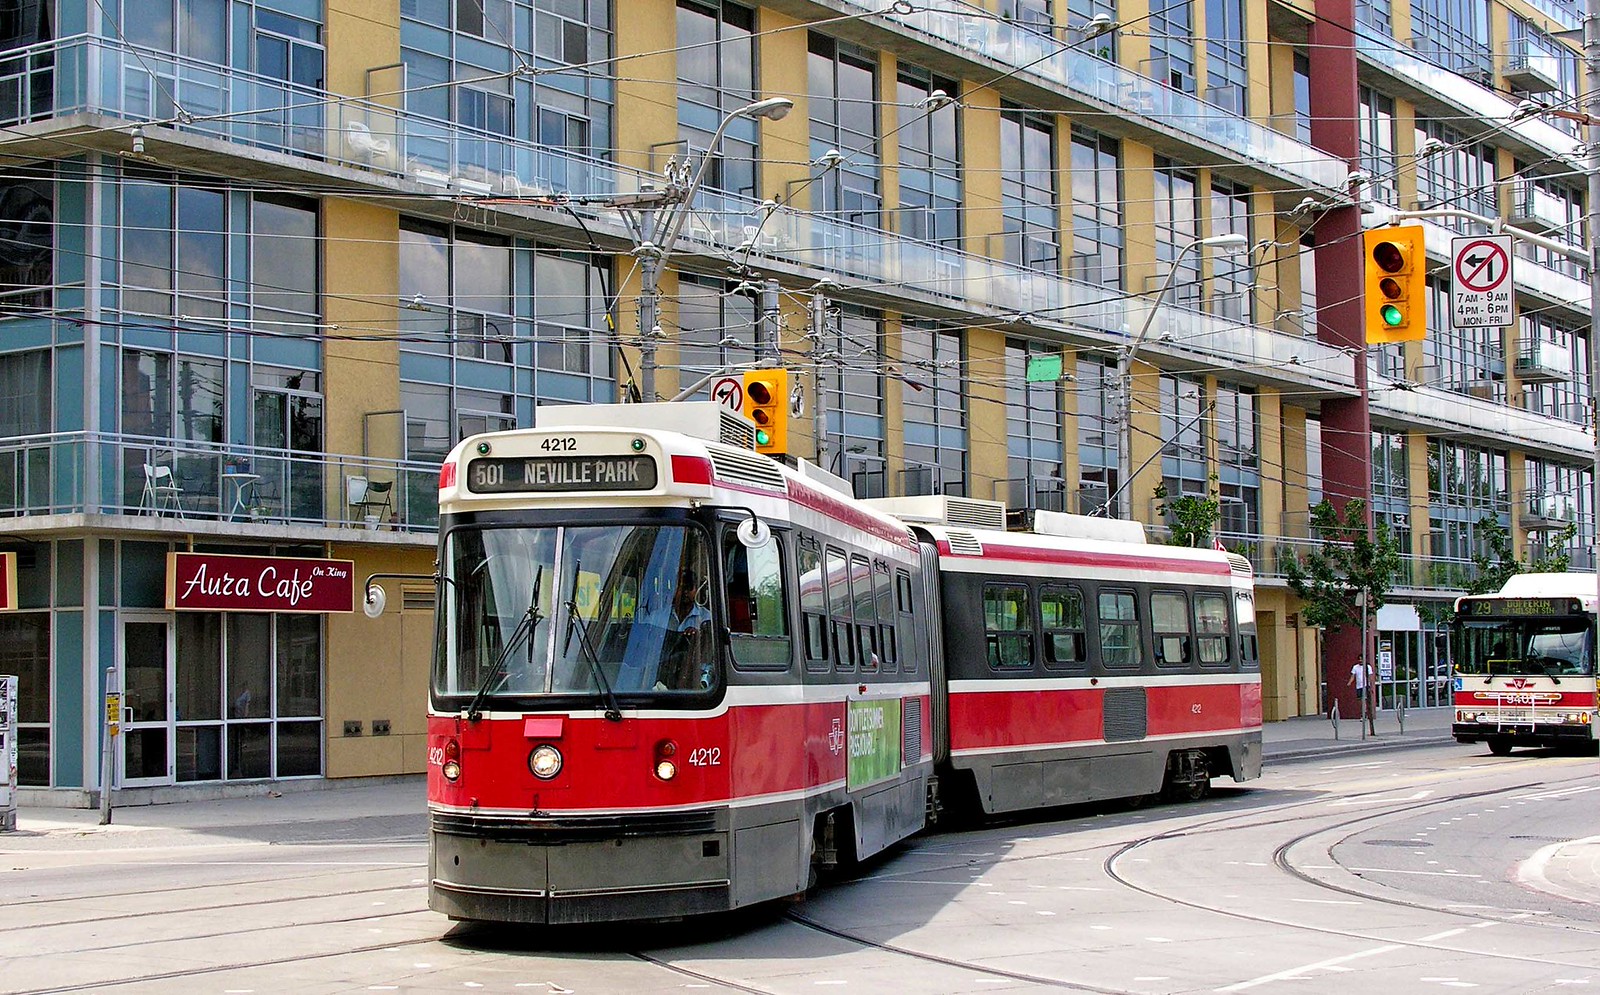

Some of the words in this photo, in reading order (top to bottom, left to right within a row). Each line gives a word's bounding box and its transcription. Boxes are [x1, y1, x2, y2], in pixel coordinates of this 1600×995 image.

[1463, 316, 1482, 325] MON
[1489, 316, 1502, 324] FRI
[540, 437, 577, 452] 4212
[475, 464, 504, 486] 501
[523, 461, 592, 485] NEVILLE
[595, 460, 639, 483] PARK
[312, 566, 324, 577] On
[325, 566, 347, 579] King
[181, 563, 250, 599] Aura
[257, 566, 313, 606] Café
[1475, 601, 1492, 615] 29
[1507, 599, 1550, 608] DUFFERIN
[688, 747, 721, 767] 4212
